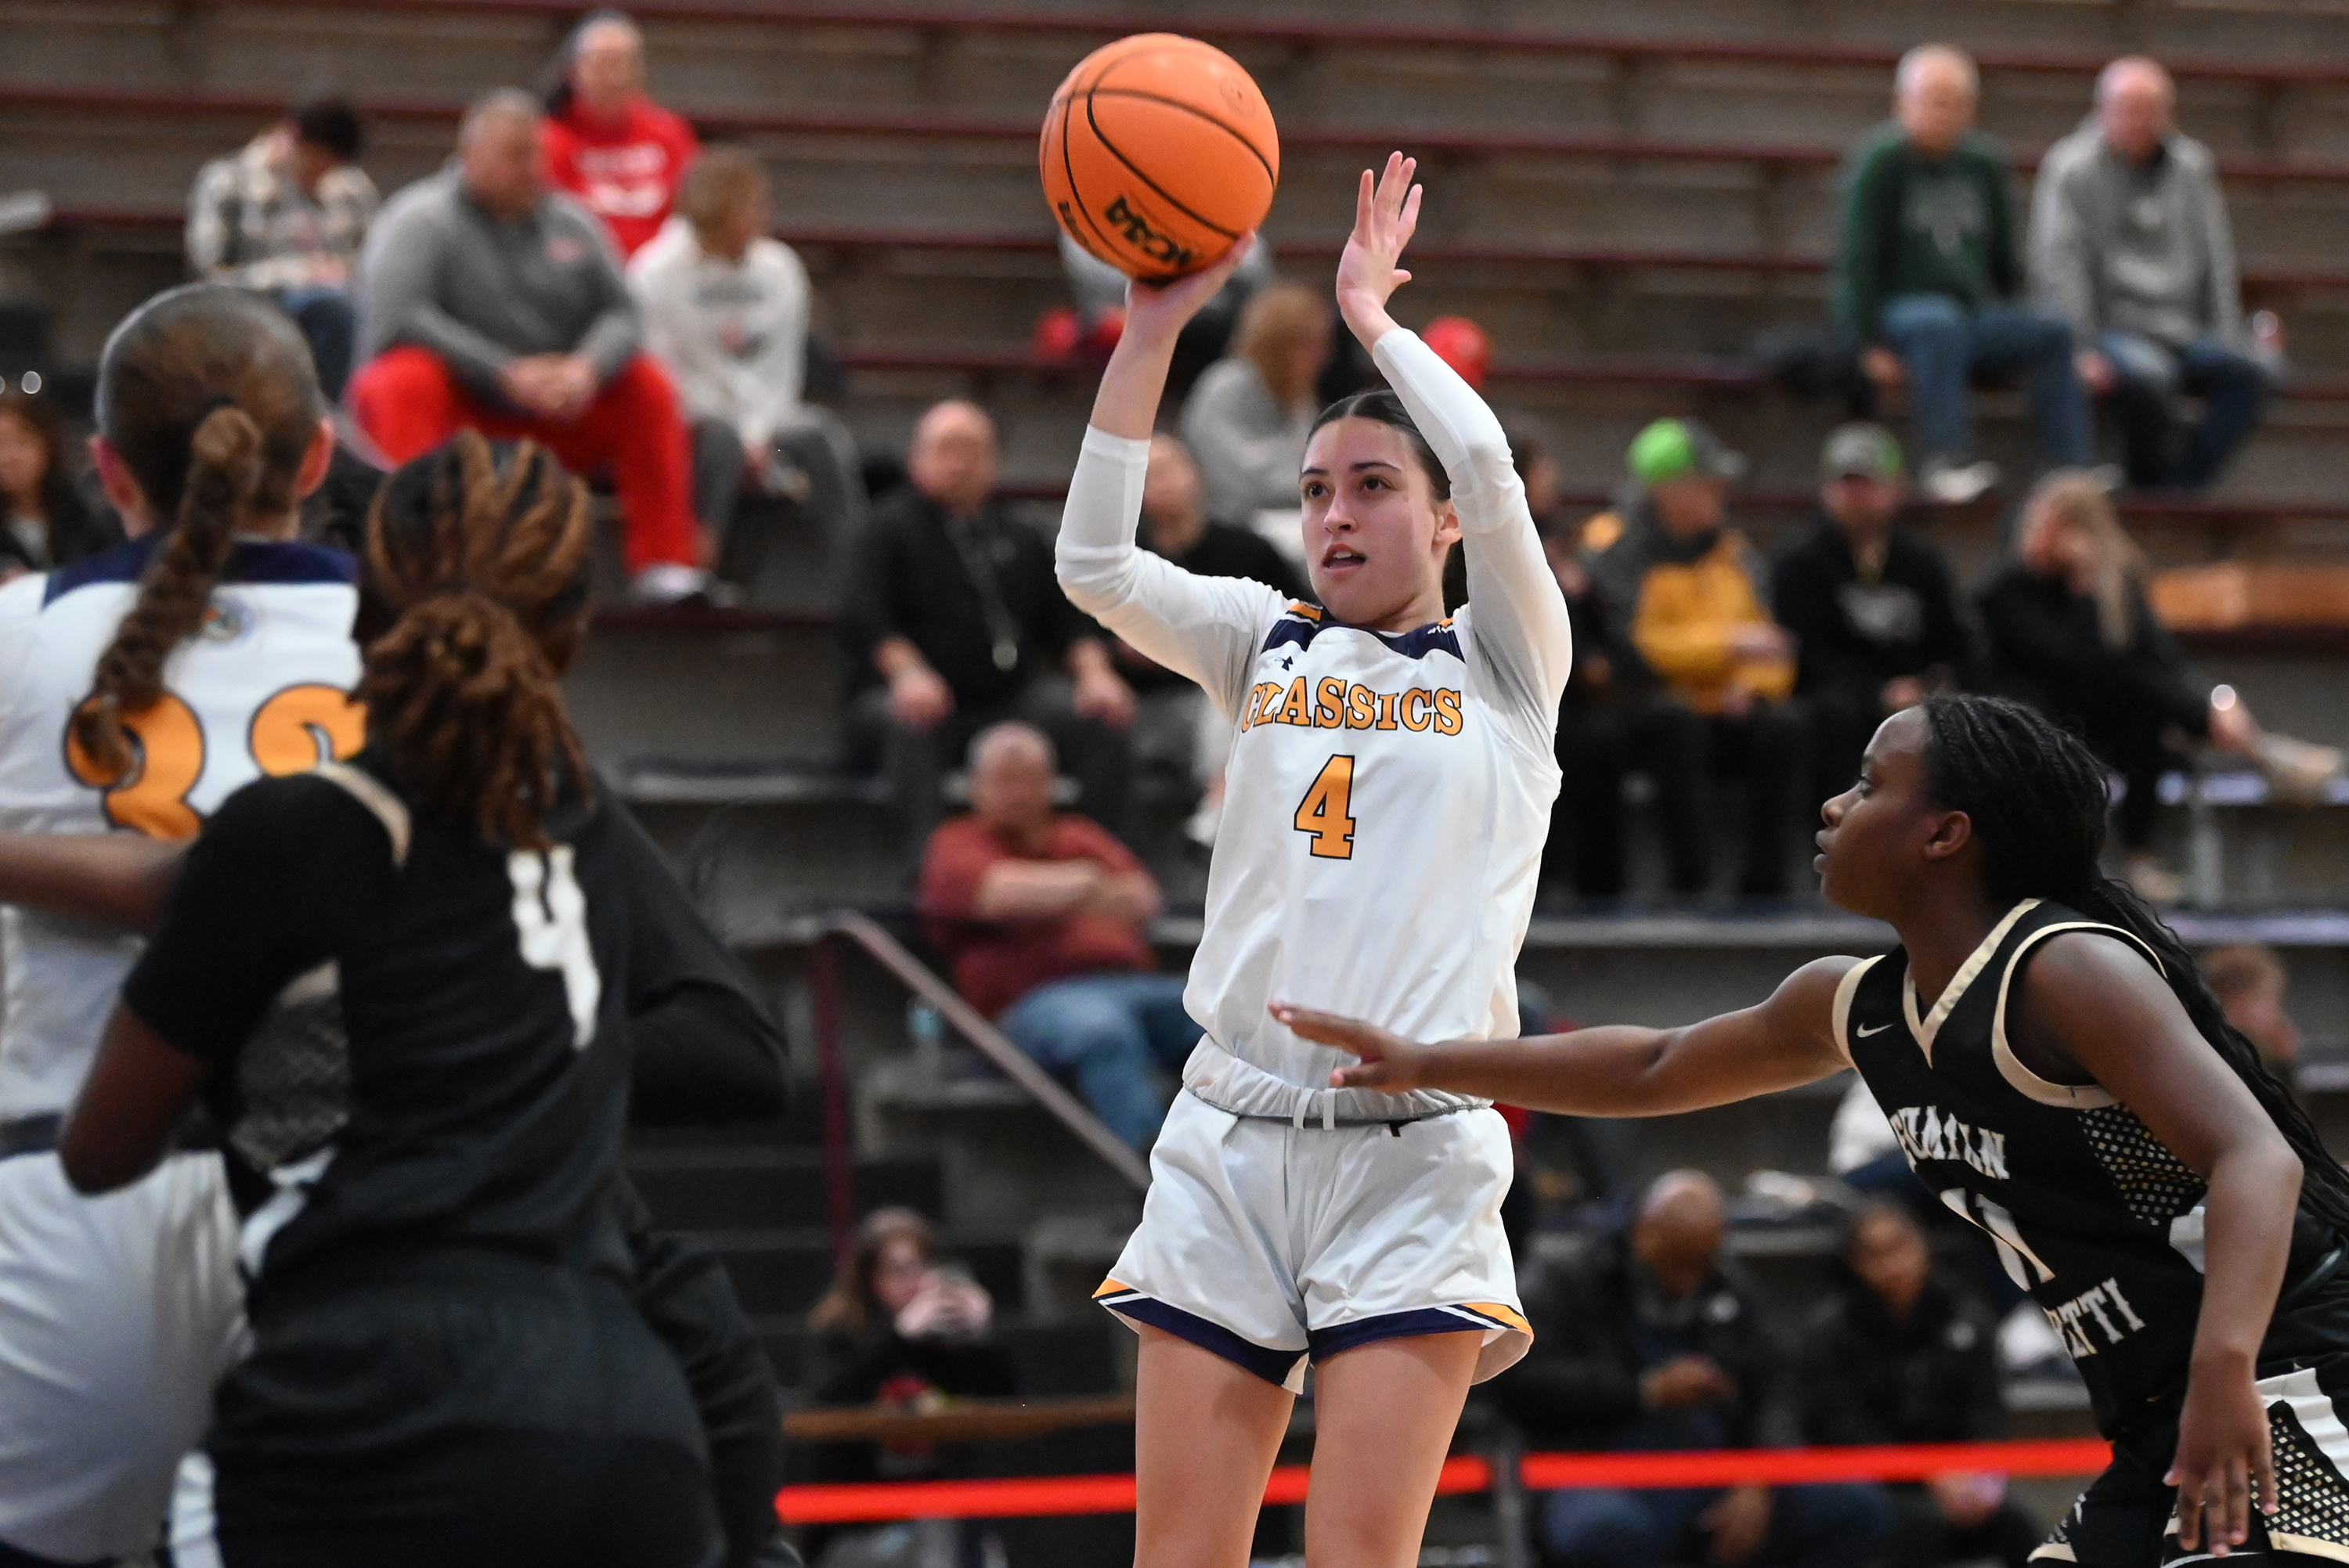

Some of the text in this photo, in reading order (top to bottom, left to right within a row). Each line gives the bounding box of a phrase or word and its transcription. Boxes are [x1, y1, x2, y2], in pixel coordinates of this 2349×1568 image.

[1241, 676, 1463, 737] CLASSICS
[1293, 753, 1357, 860] 4
[506, 842, 601, 1051] 4
